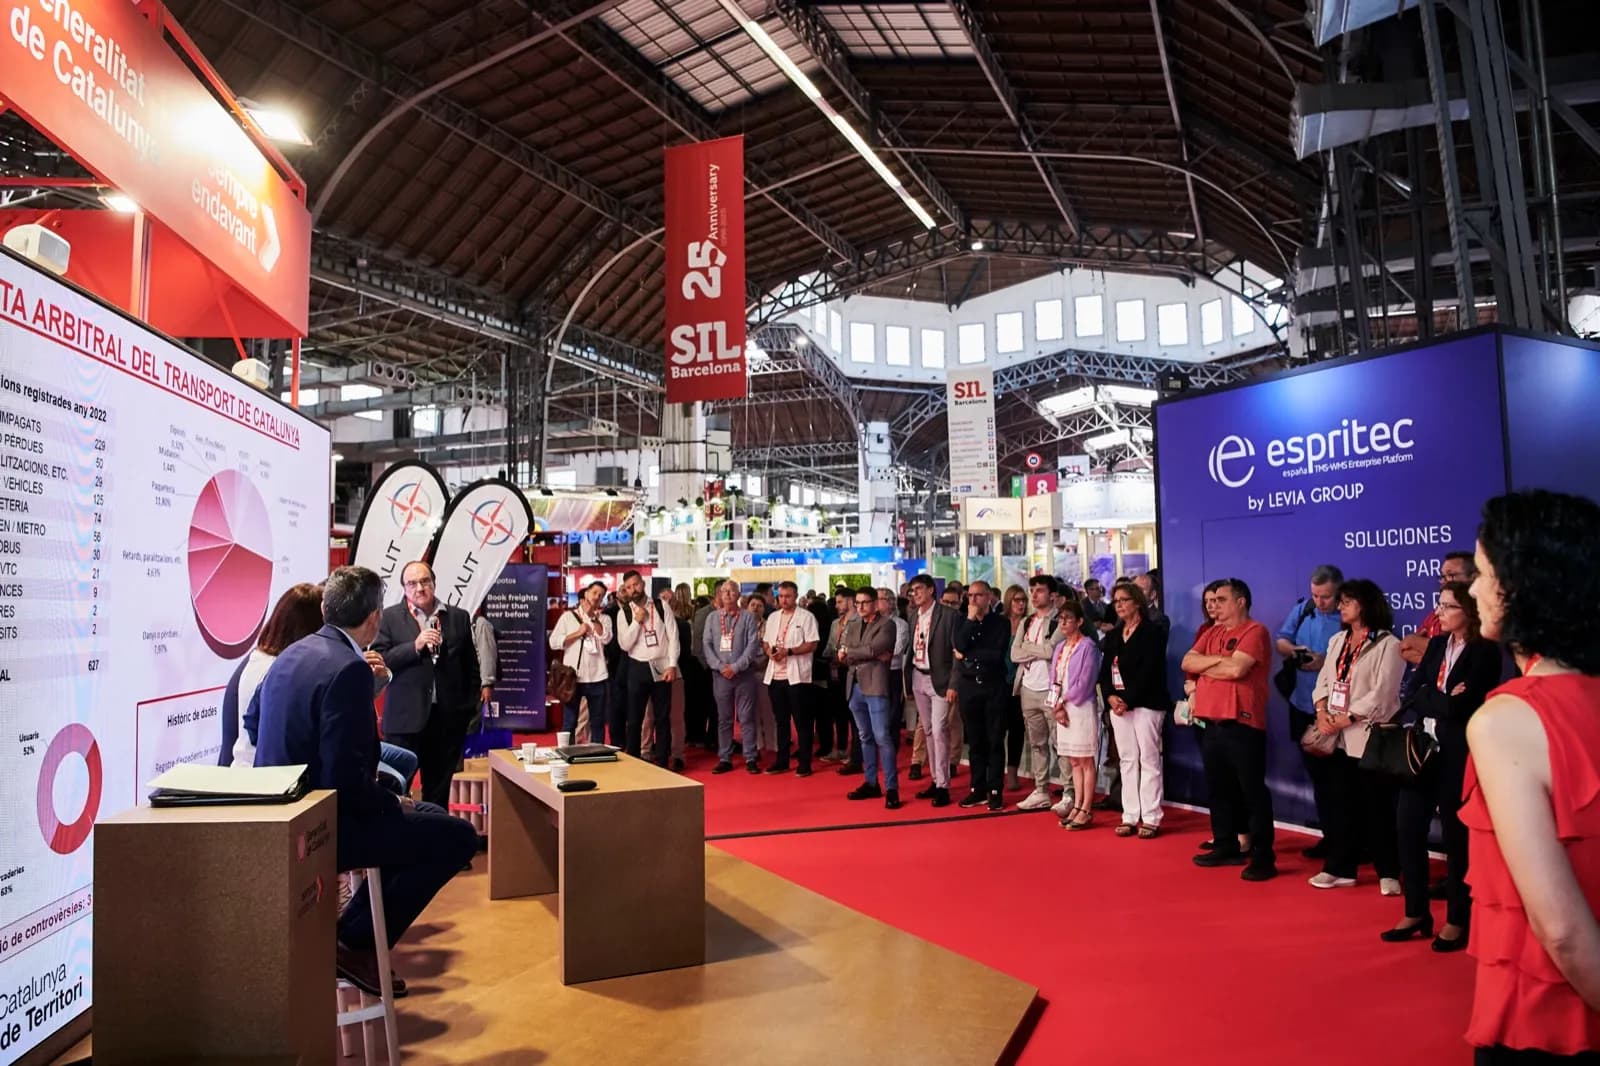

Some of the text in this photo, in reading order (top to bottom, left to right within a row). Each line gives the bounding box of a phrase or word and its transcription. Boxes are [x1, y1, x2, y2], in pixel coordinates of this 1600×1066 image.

[10, 5, 45, 61] de
[708, 163, 721, 240] Anniversary
[191, 177, 257, 255] endavant
[682, 239, 727, 300] 25
[670, 320, 741, 366] SIL
[32, 297, 127, 366] ARBITRAL
[132, 345, 160, 382] DEL
[164, 361, 236, 416] TRANSPORT
[238, 399, 252, 423] DE
[253, 407, 300, 447] CATALUNYA
[670, 361, 742, 380] Barcelona
[954, 381, 987, 399] SIL
[23, 385, 72, 411] registrades
[74, 402, 89, 419] any
[89, 406, 107, 423] 2022
[954, 398, 987, 407] Barcelona
[1266, 418, 1415, 474] espritec
[1348, 455, 1382, 470] Enterprise
[1382, 452, 1414, 466] Platform
[52, 465, 69, 481] ETC.
[4, 475, 44, 495] VEHICLES
[1248, 482, 1365, 512] by LEVIA GROUP
[17, 521, 46, 536] METRO
[1344, 524, 1453, 549] SOLUCIONES
[486, 601, 529, 610] easier than
[487, 592, 539, 603] Book freights
[504, 610, 530, 619] before
[88, 659, 100, 672] 627
[11, 931, 23, 947] de
[0, 975, 83, 1051] de Territori
